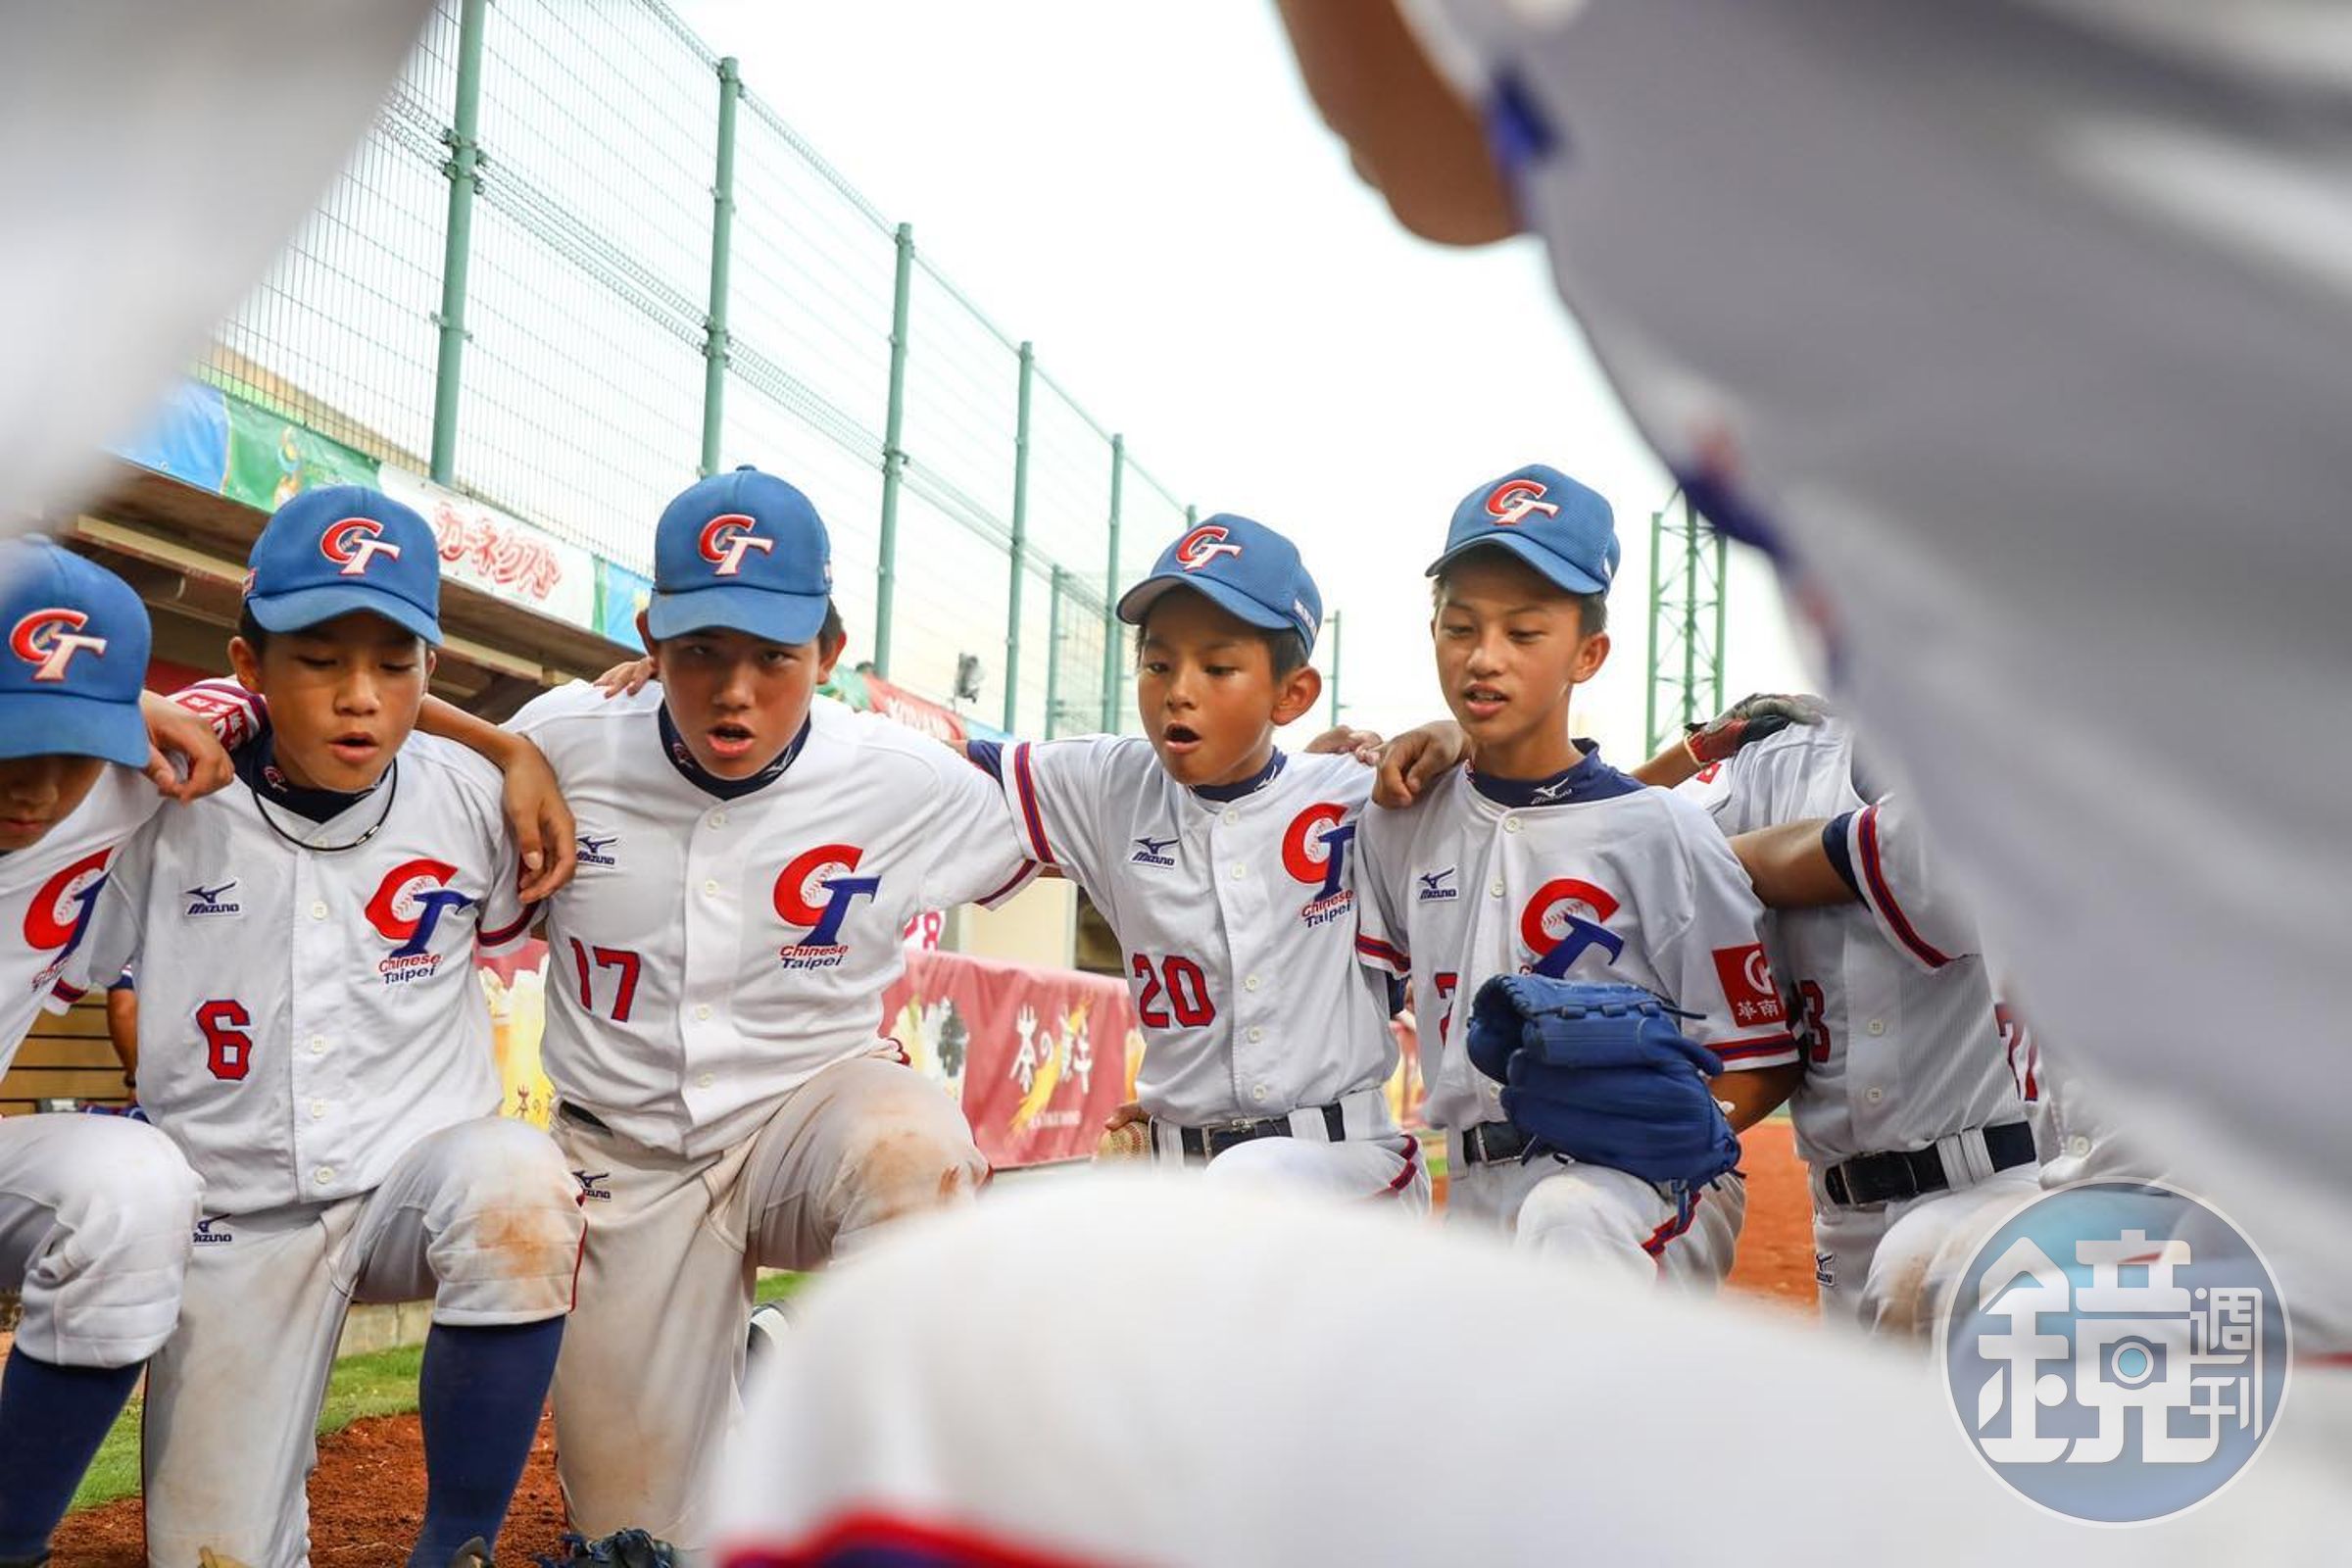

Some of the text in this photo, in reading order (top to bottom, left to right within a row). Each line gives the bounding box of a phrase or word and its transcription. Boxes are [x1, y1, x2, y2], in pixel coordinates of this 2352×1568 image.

[1304, 900, 1350, 928] Taipei
[780, 945, 850, 956] Chinese
[378, 954, 442, 973] Chinese
[383, 964, 437, 984] Taipei
[782, 956, 844, 970] Taipei
[568, 936, 642, 1023] 17
[1132, 953, 1217, 1029] 20
[195, 999, 253, 1080] 6
